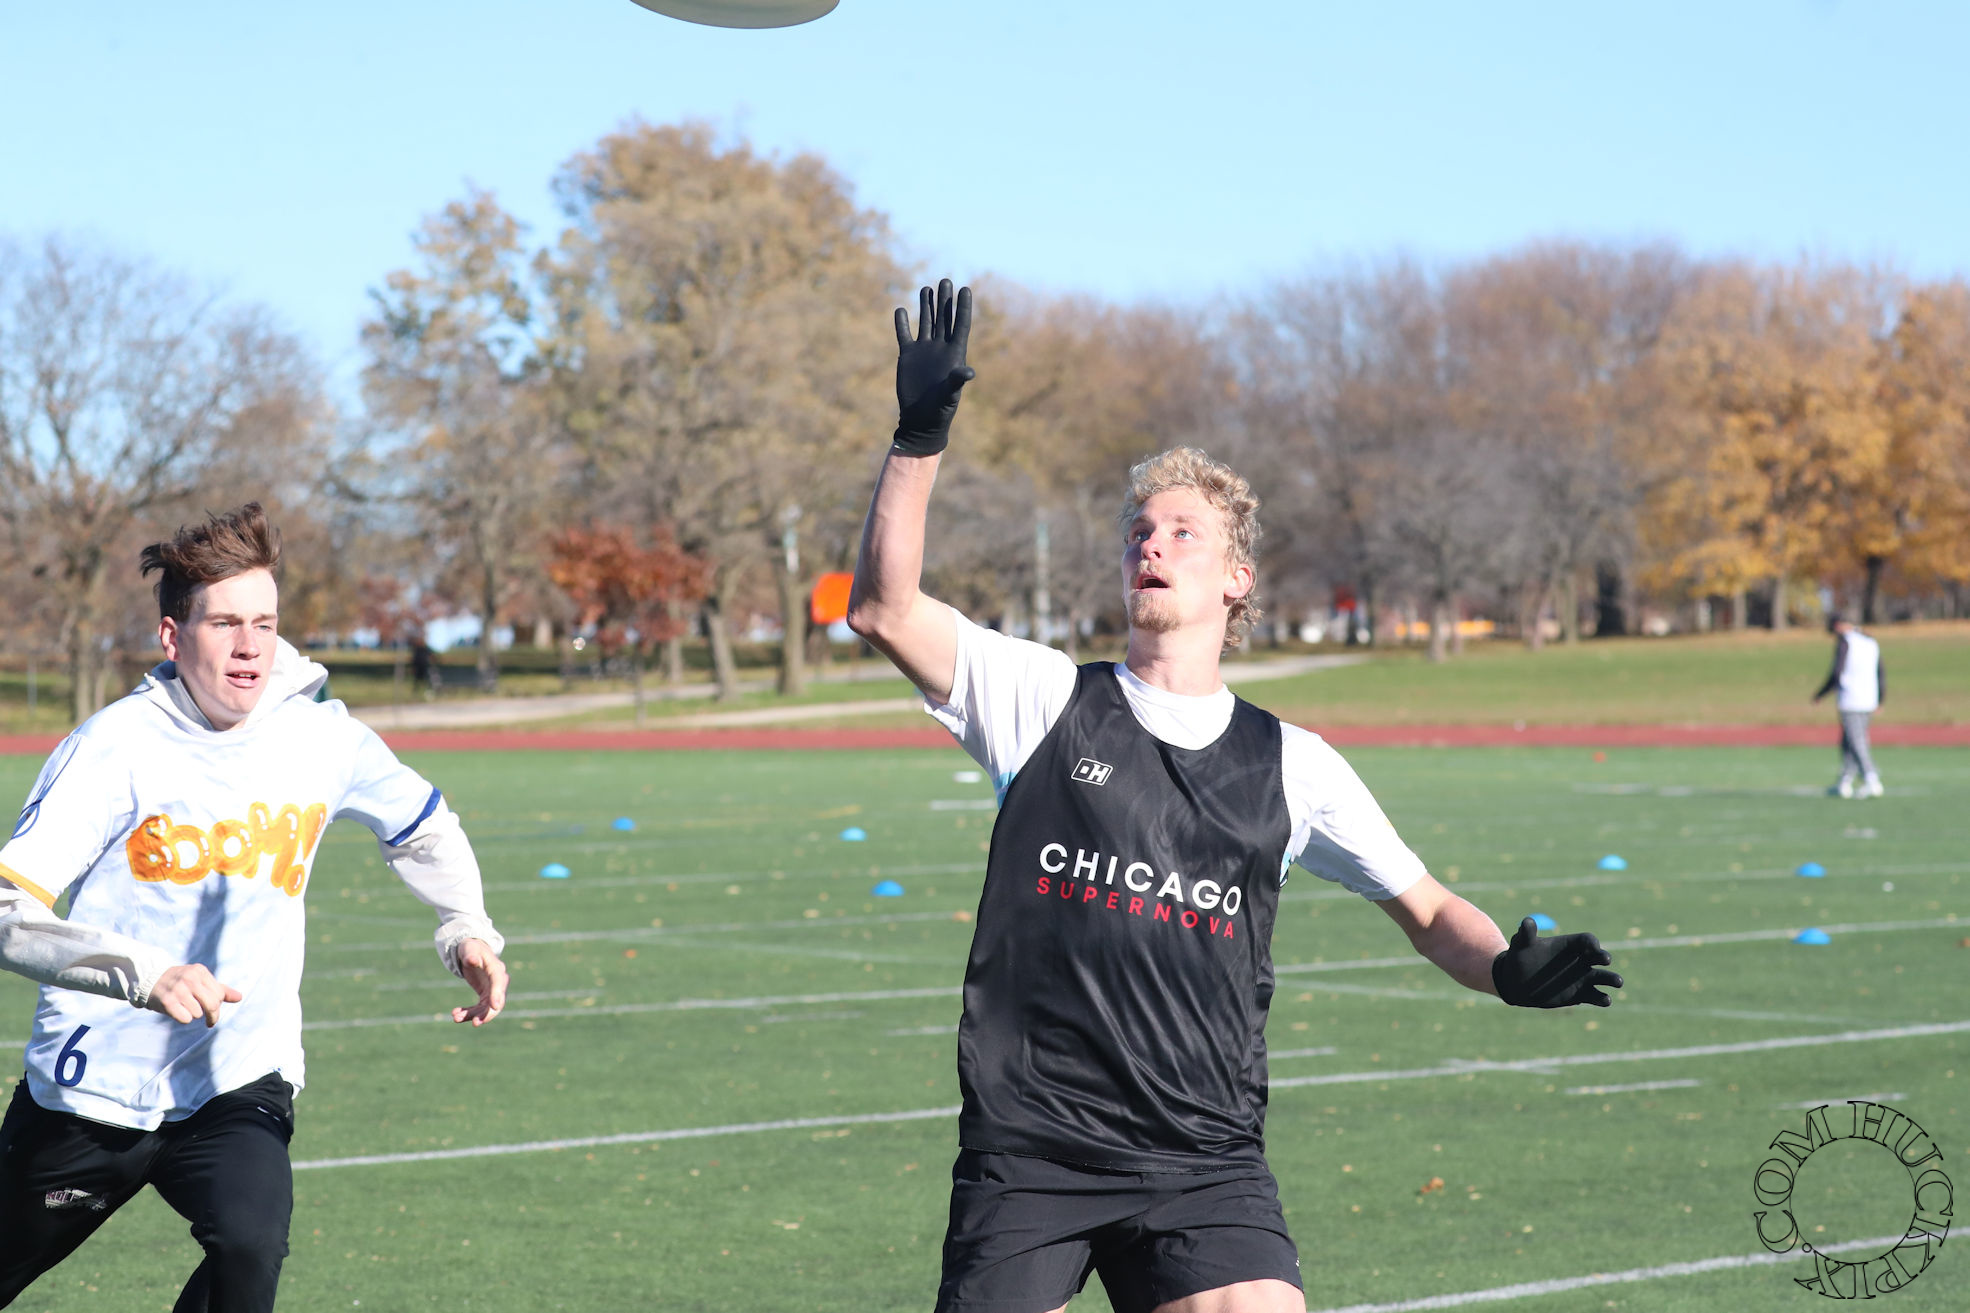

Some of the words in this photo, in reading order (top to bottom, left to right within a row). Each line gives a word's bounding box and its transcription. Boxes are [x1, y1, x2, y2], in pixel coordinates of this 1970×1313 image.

[1036, 877, 1235, 939] SUPERNOVA
[1039, 842, 1242, 915] CHICAGO
[54, 1024, 91, 1087] 6
